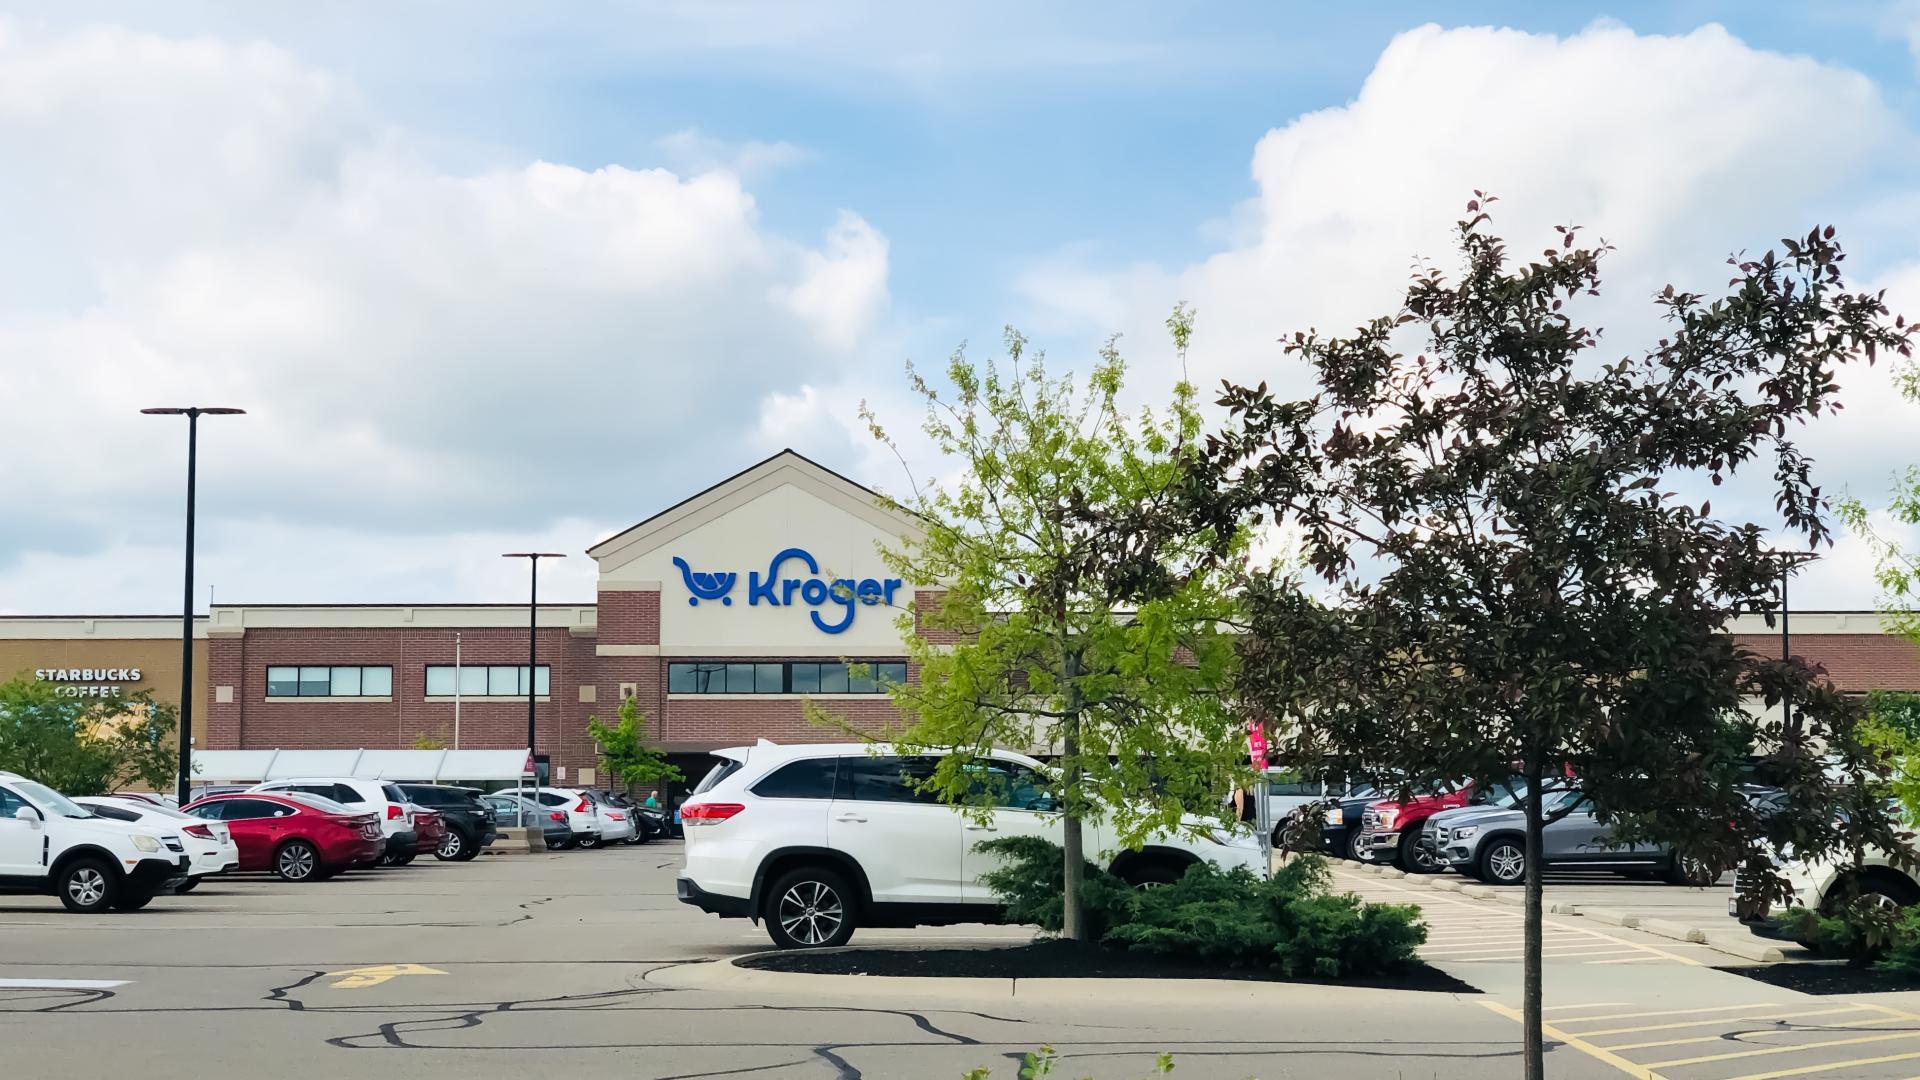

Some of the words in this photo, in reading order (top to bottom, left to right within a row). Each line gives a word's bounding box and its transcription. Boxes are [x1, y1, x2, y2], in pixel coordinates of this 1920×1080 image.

[749, 548, 902, 634] Kroger
[35, 668, 142, 681] STARBUCKS
[54, 685, 121, 698] COFFEE
